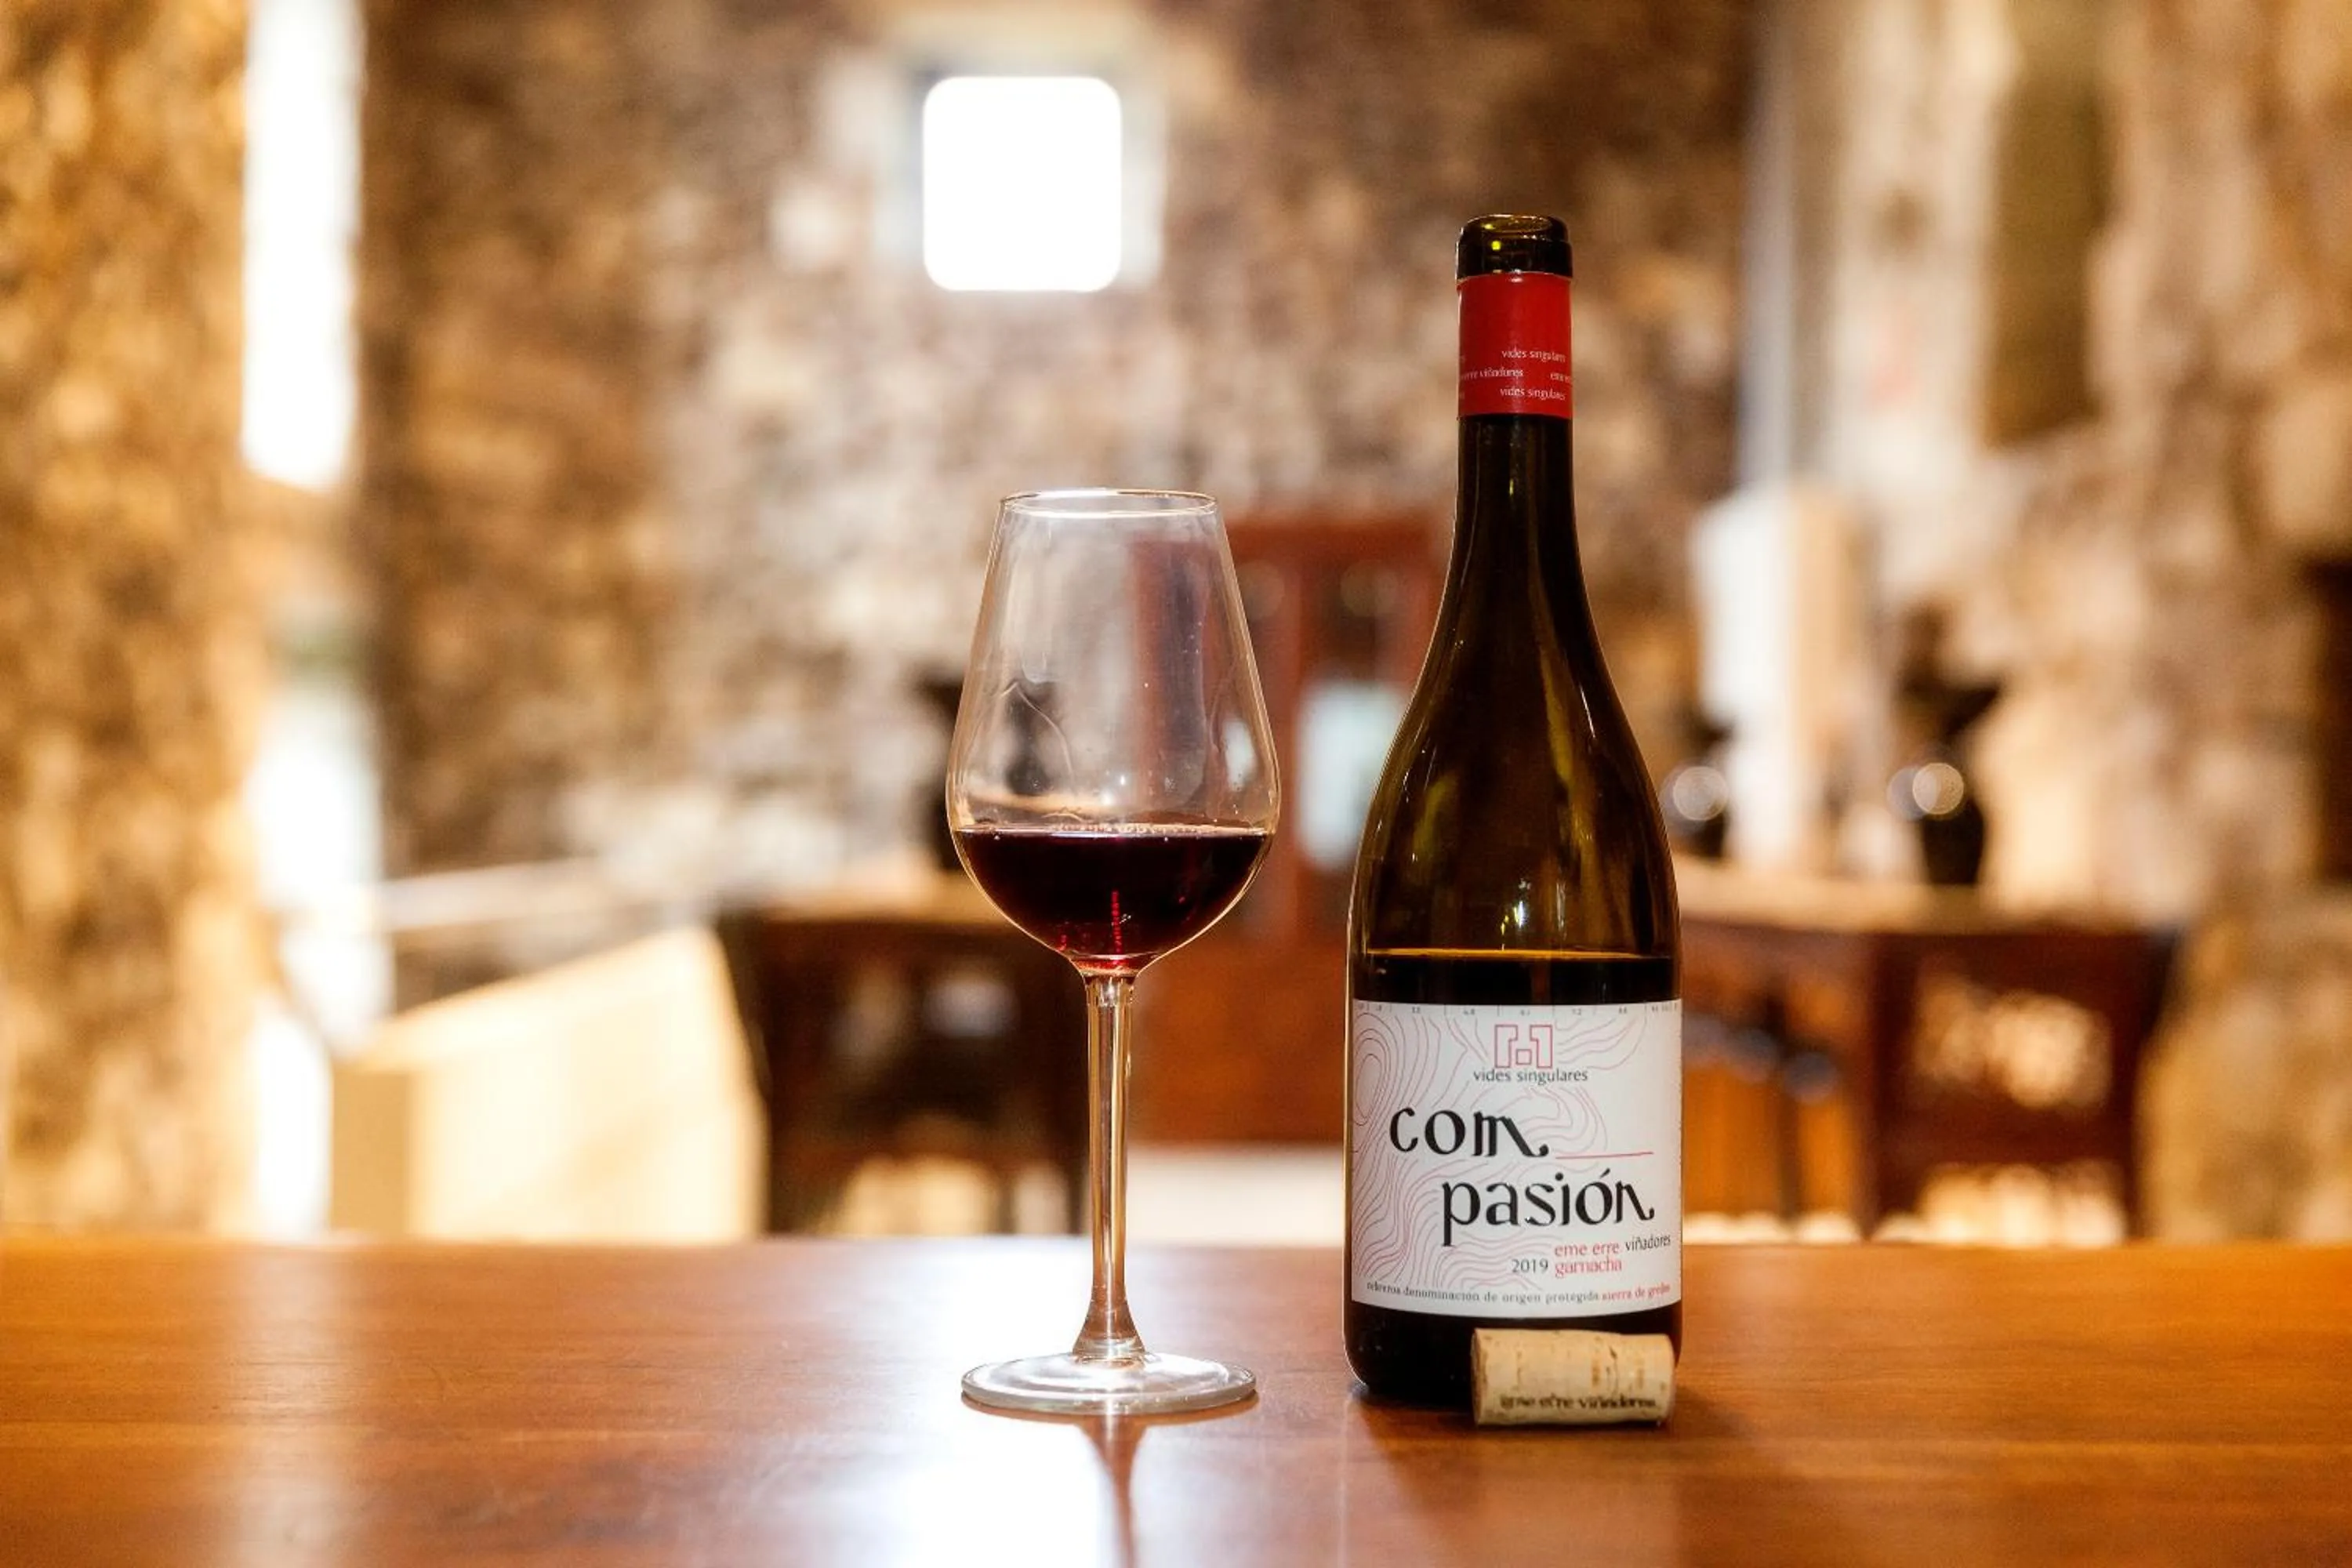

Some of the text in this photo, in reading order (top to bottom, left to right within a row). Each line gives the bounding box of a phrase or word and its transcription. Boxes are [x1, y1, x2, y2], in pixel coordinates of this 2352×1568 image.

[1473, 1069, 1588, 1086] vides singulares
[1390, 1106, 1550, 1158] com
[1442, 1168, 1655, 1247] pasión
[1555, 1234, 1671, 1257] eme erre viñadores
[1512, 1258, 1548, 1273] 2019
[1555, 1256, 1622, 1278] garnacha
[1483, 1291, 1495, 1302] de
[1501, 1292, 1541, 1305] origen
[1635, 1287, 1646, 1298] de
